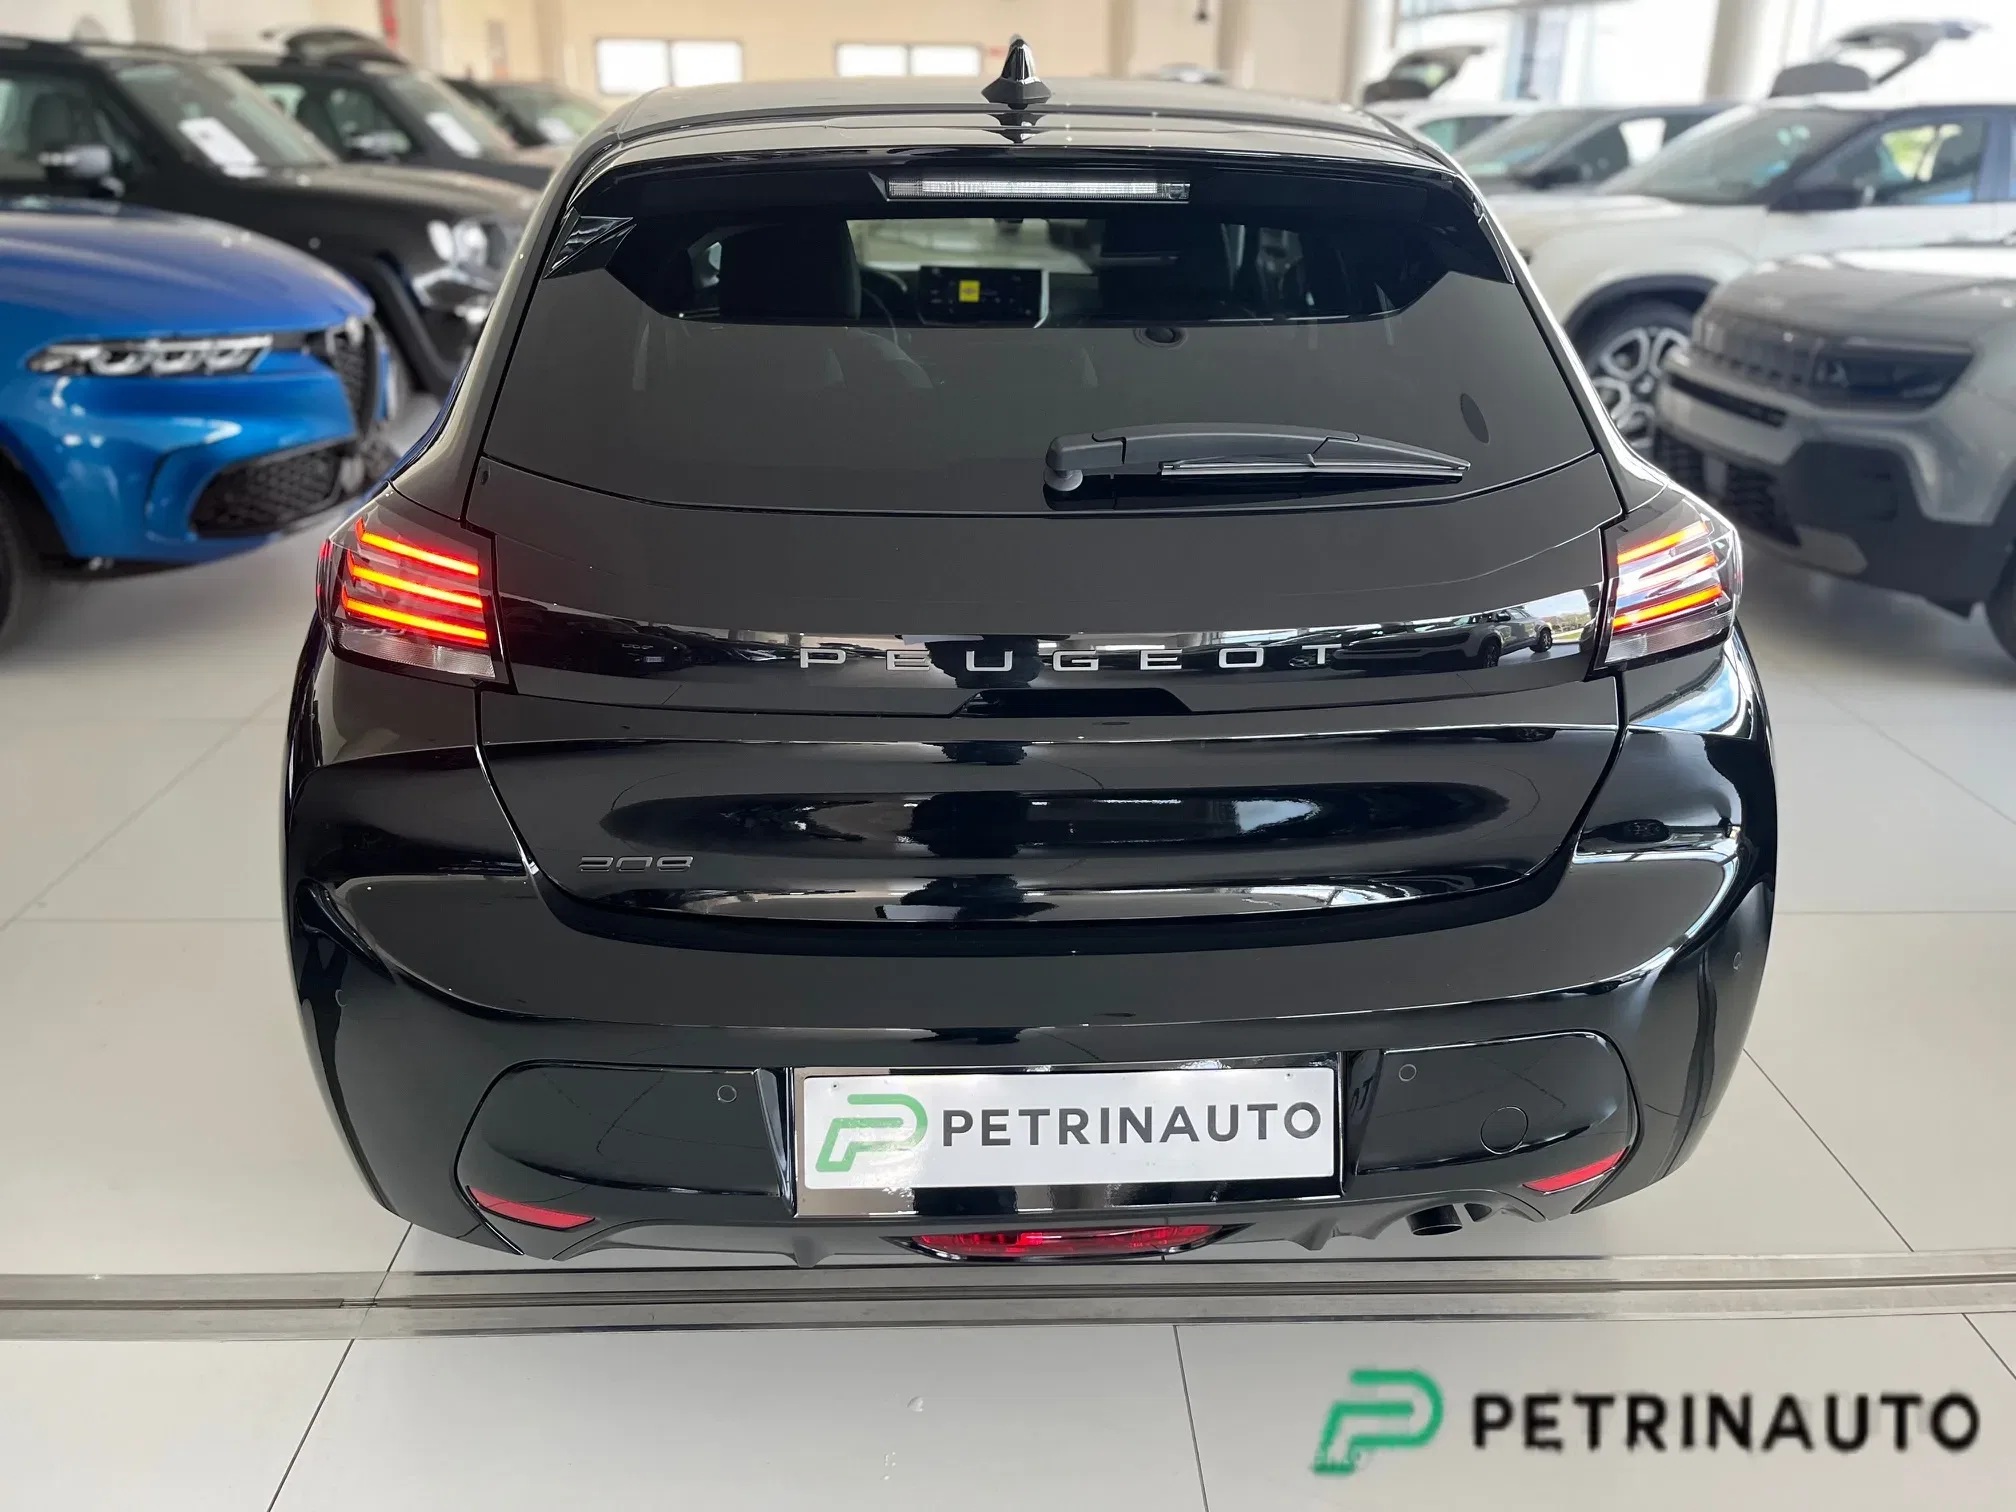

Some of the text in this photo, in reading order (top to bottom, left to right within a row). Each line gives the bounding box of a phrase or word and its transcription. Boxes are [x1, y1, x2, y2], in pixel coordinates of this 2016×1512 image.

[800, 645, 1341, 671] PEUGEOT
[578, 856, 694, 873] 208
[942, 1102, 1321, 1147] PETRINAUTO
